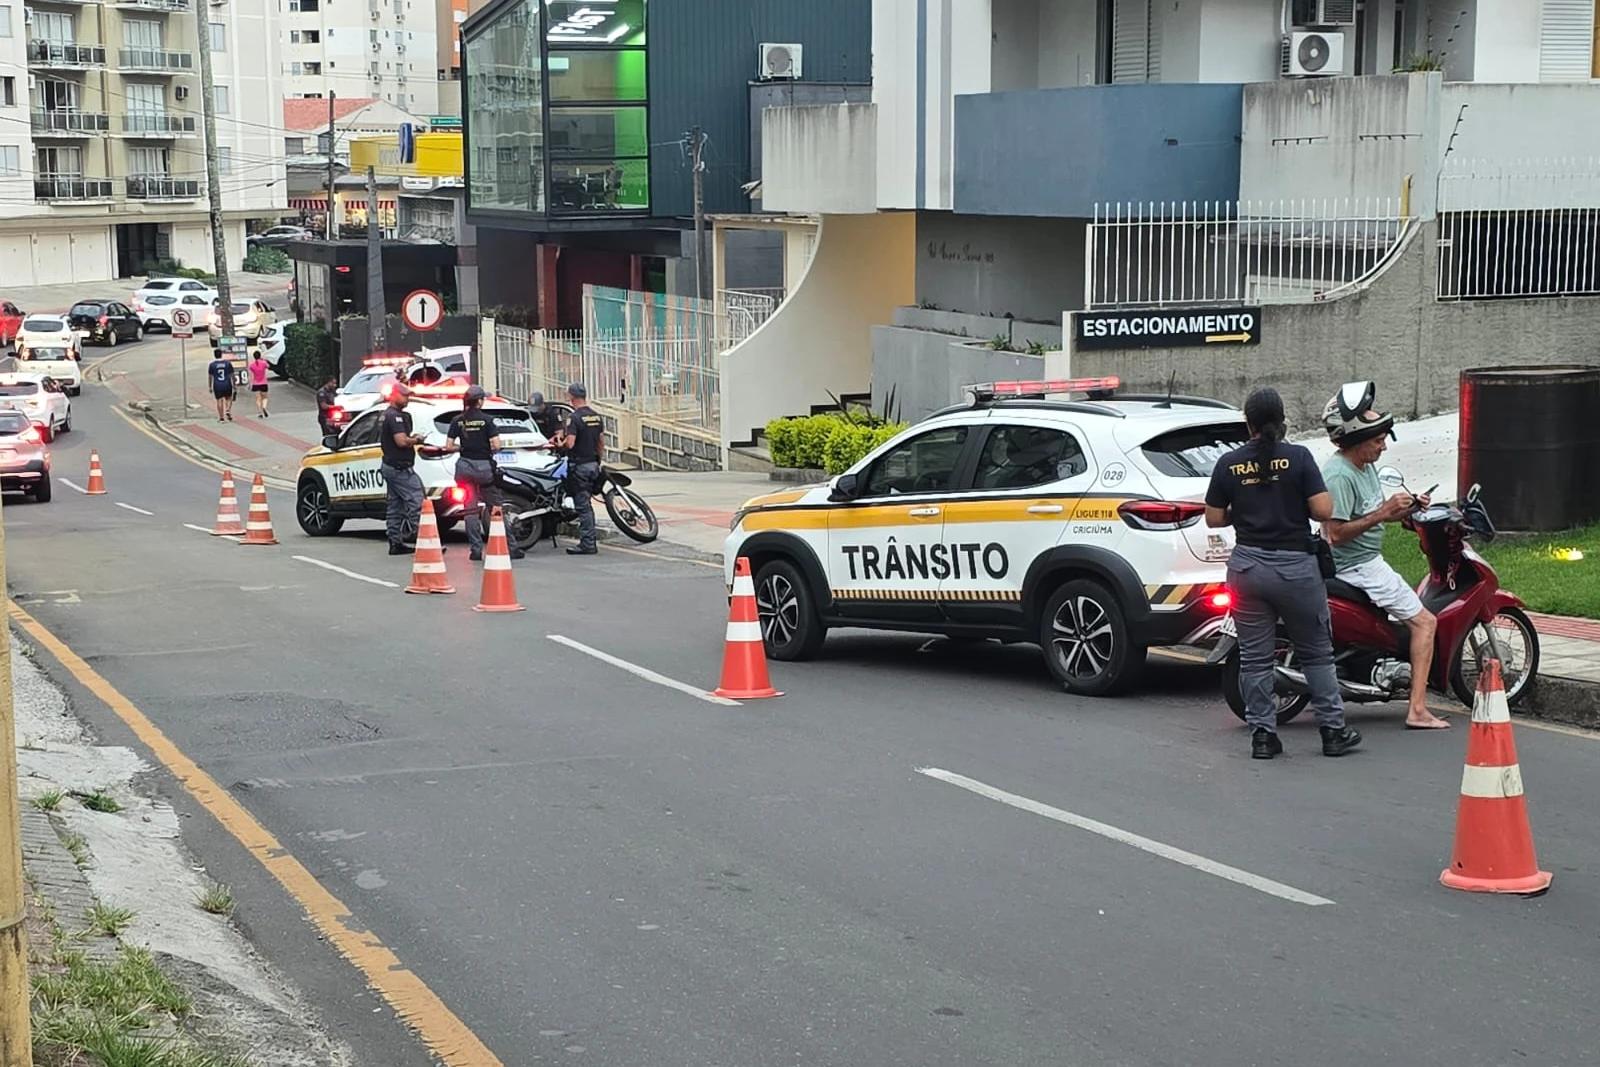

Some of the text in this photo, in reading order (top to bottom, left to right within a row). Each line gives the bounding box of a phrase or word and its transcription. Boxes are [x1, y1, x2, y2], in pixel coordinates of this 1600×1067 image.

[1083, 313, 1254, 337] ESTACIONAMENTO
[217, 369, 225, 381] 3
[333, 467, 384, 492] TRÂNSITO
[1076, 510, 1100, 519] LIGUE
[1073, 524, 1113, 534] CRICIÚMA
[841, 536, 1009, 580] TRÂNSITO
